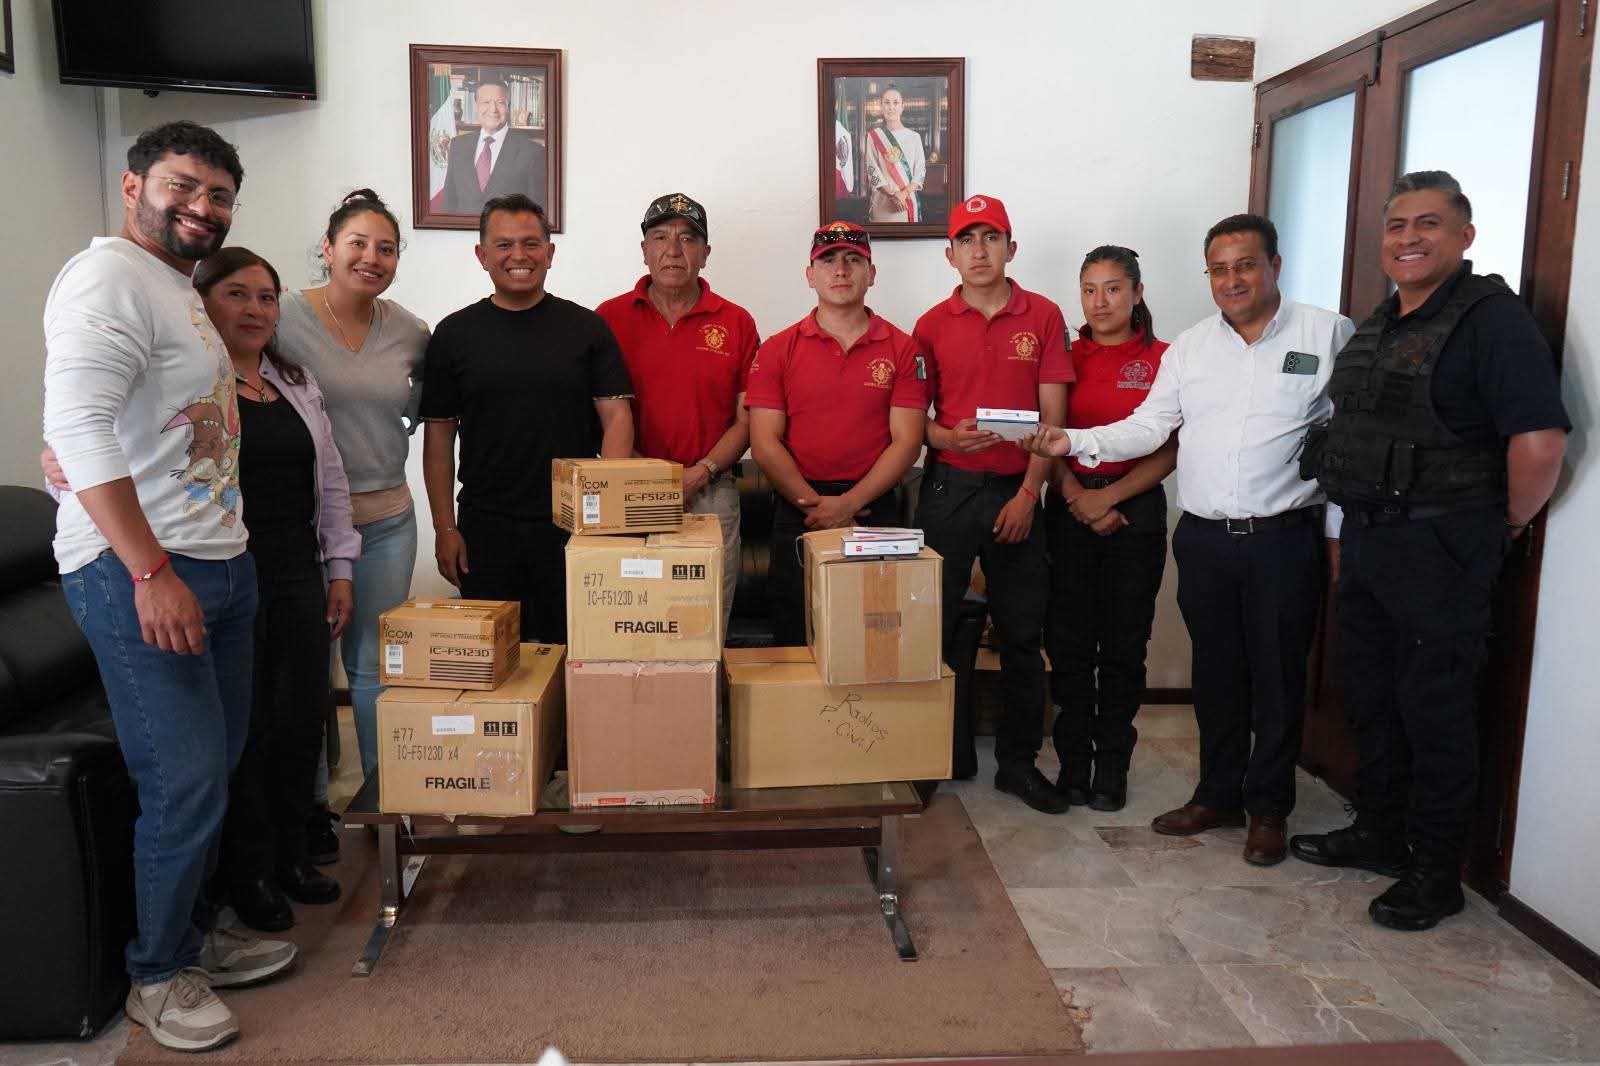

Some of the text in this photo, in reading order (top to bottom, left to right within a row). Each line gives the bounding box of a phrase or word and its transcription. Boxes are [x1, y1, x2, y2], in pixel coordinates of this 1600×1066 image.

[625, 492, 680, 502] IC-F5123D
[583, 573, 604, 587] #77
[587, 590, 633, 606] IC-F5123D
[638, 590, 648, 605] x4
[614, 621, 678, 634] FRAGILE
[430, 647, 490, 657] IC-F5123D
[393, 727, 414, 742] #77
[397, 745, 443, 760] IC-F5123D
[448, 745, 459, 760] x4
[425, 777, 490, 791] FRAGILE
